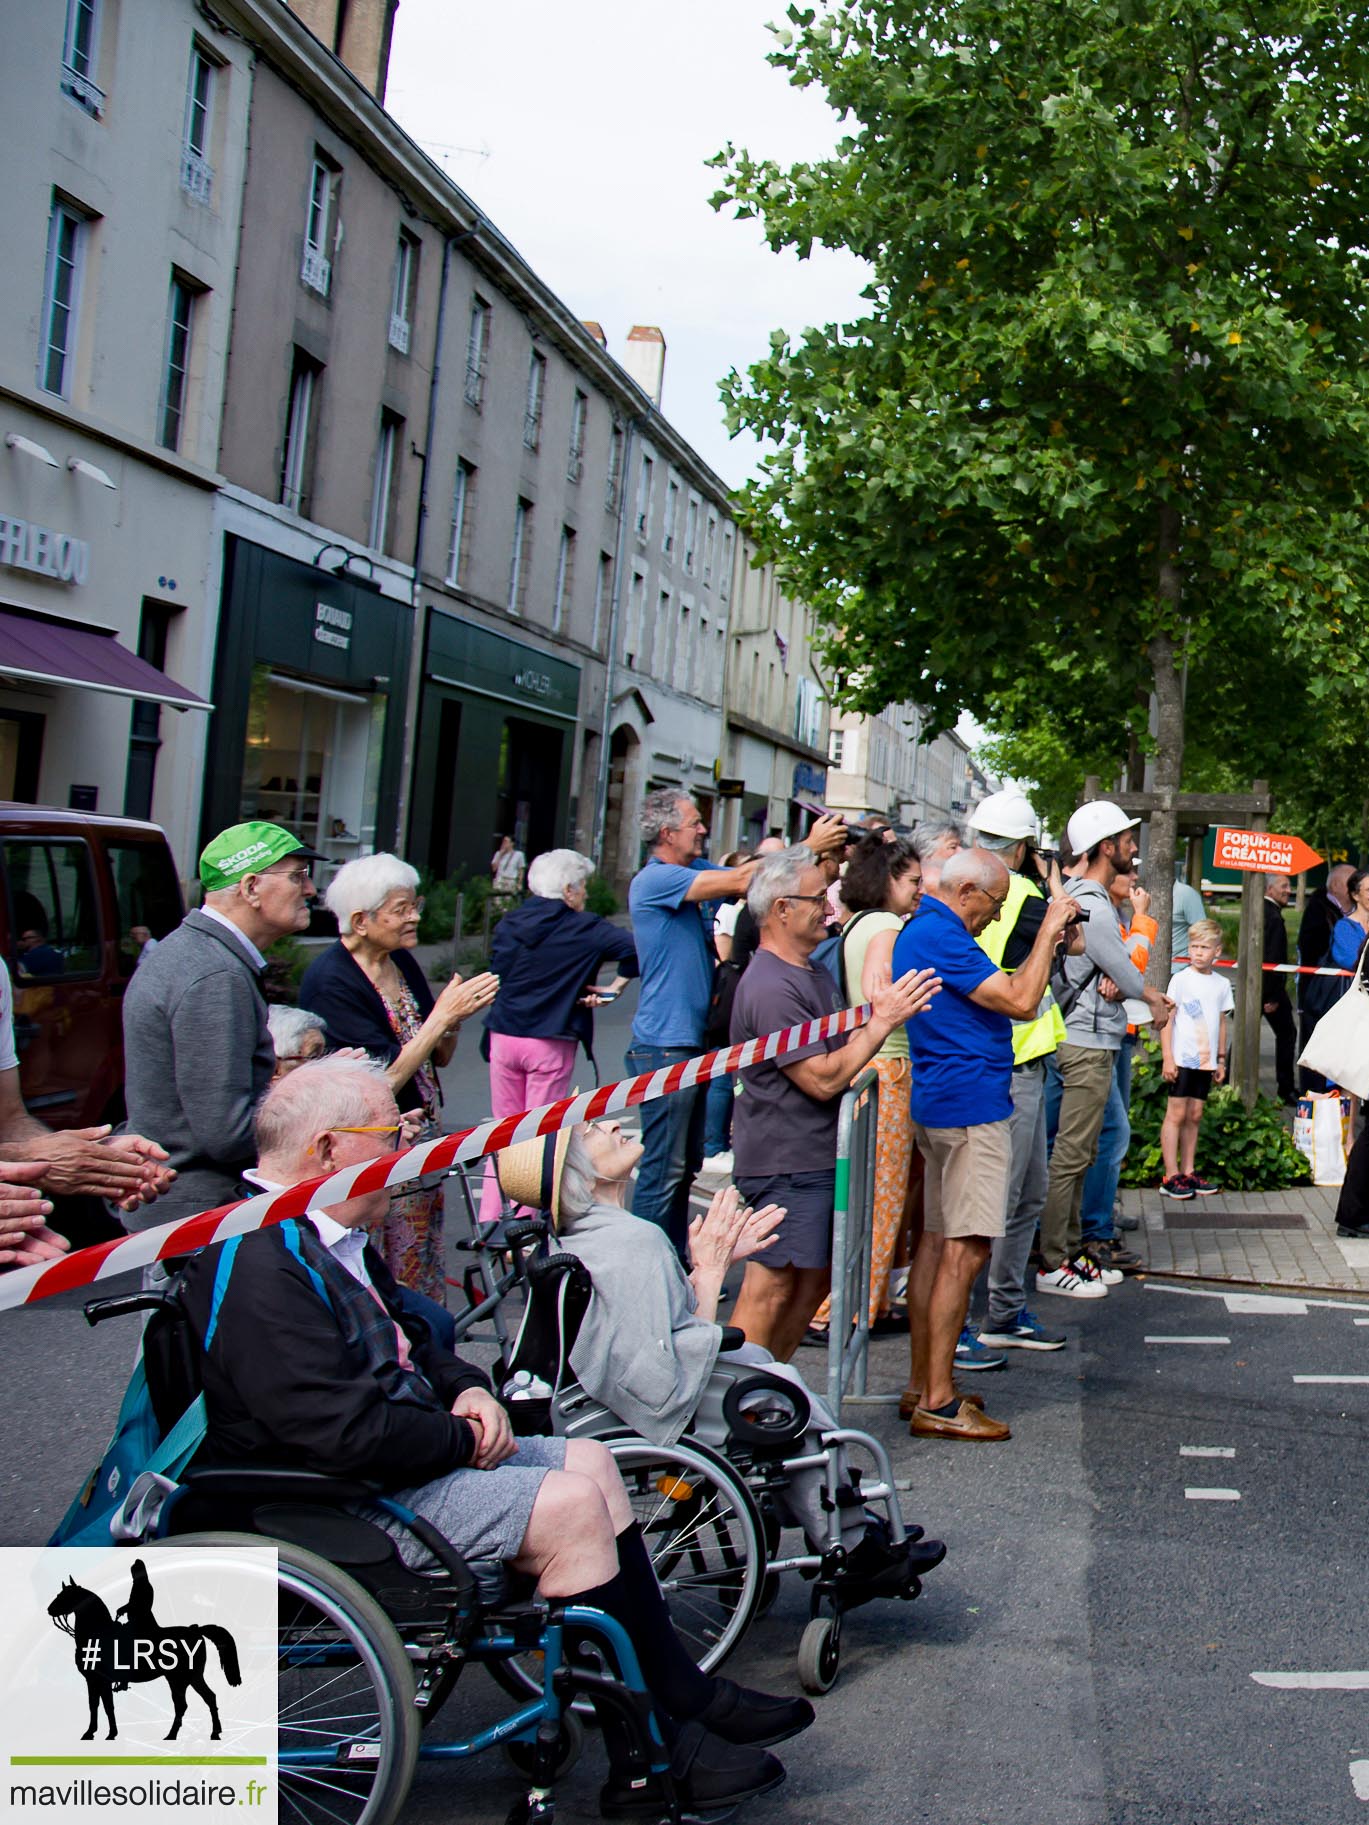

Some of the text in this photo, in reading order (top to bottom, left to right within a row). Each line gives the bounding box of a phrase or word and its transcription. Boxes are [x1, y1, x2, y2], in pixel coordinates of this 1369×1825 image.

[1222, 842, 1291, 865] CRÉATION
[1224, 832, 1293, 852] FORUM DE LA
[217, 841, 269, 870] ŠKODA
